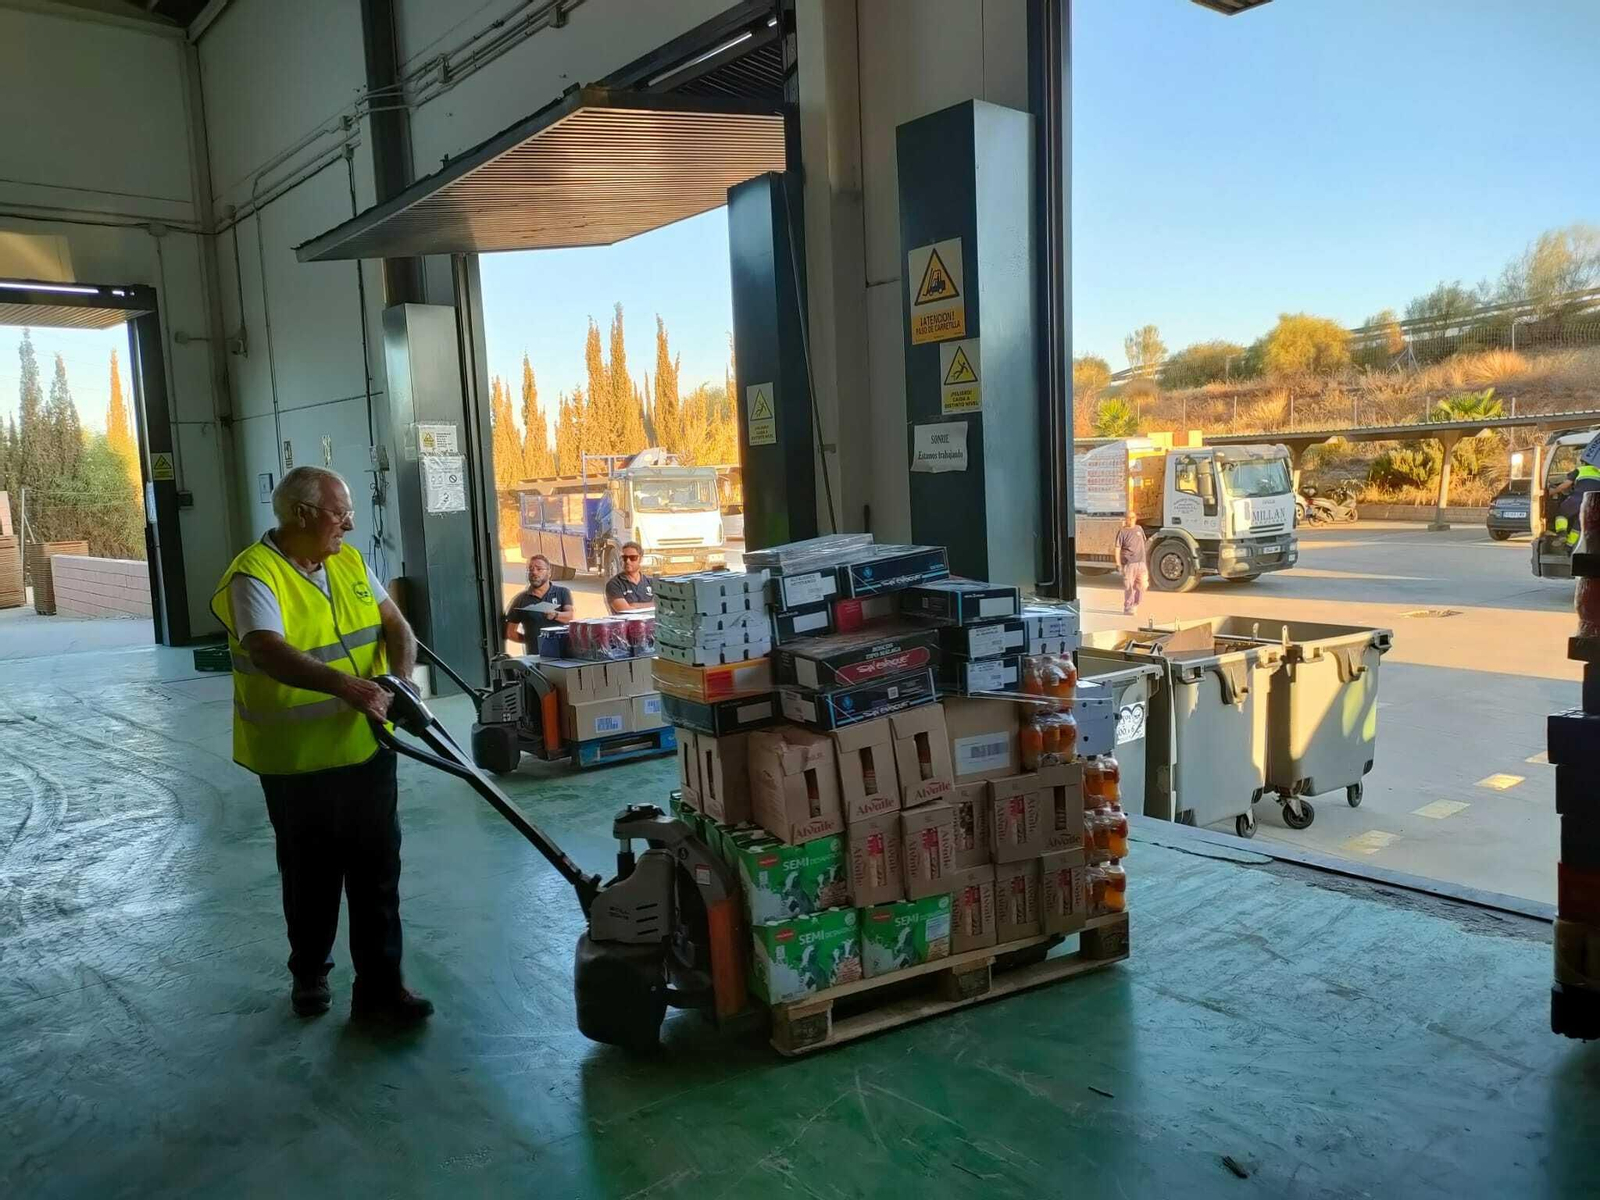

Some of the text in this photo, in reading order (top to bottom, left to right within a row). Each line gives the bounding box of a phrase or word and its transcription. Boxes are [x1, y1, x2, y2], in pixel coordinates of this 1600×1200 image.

[935, 319, 961, 332] CARRETILLA
[918, 449, 964, 460] Estamos trabajando
[914, 781, 951, 801] Alvalle
[857, 799, 894, 817] Alvalle
[794, 821, 835, 841] Alvalle
[782, 857, 809, 871] SEMI
[895, 913, 920, 928] SEMI
[799, 930, 825, 946] SEMI
